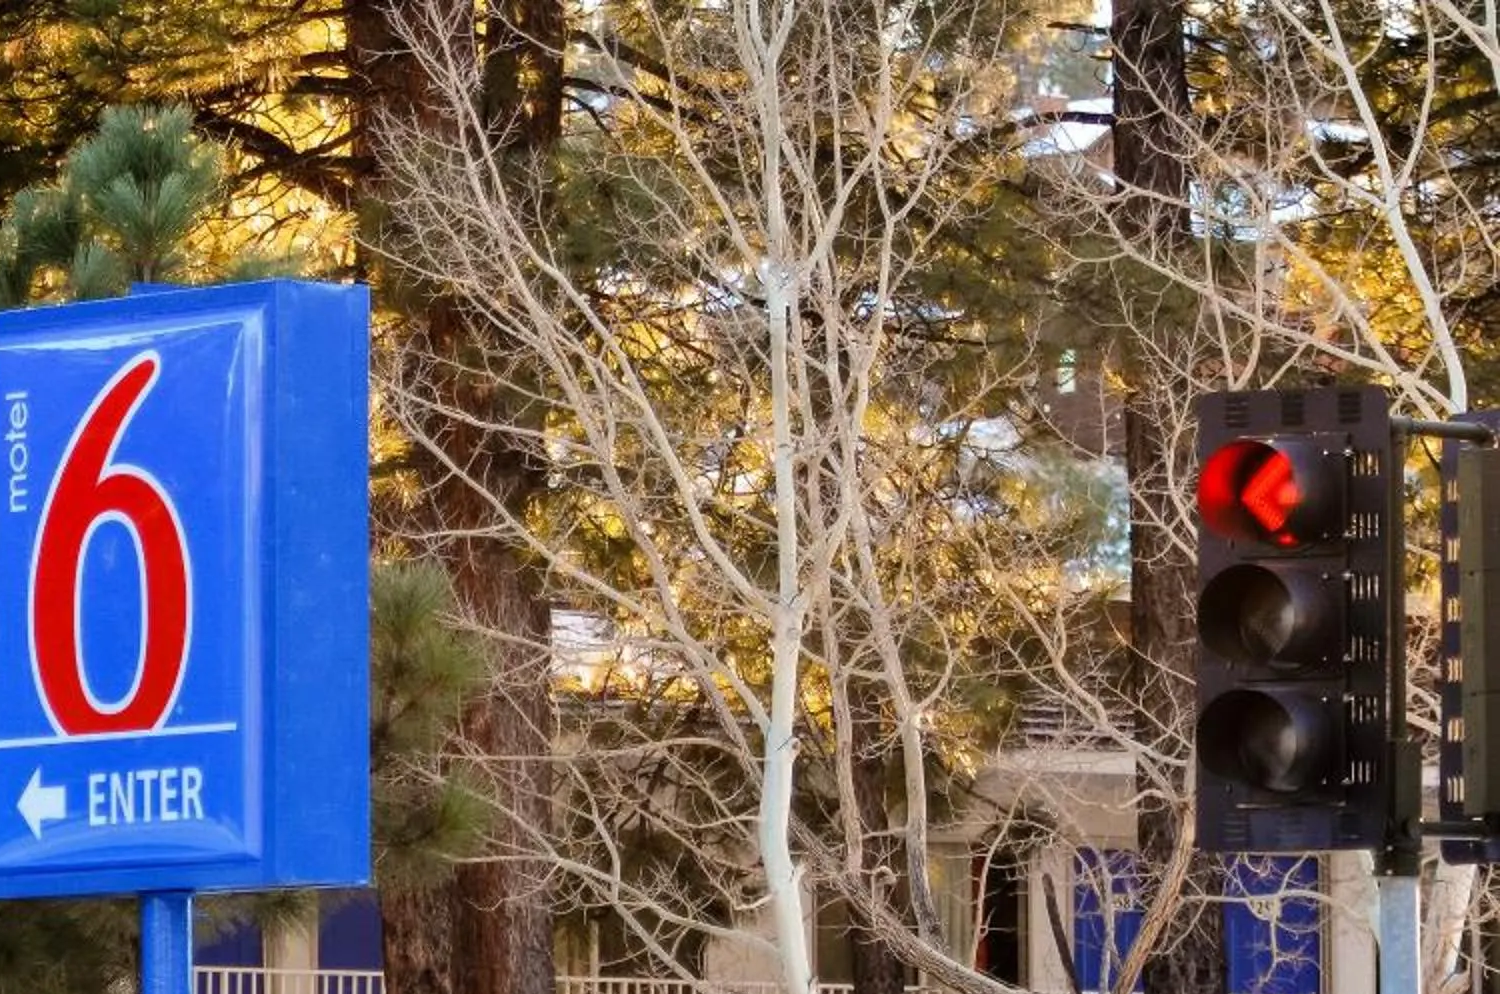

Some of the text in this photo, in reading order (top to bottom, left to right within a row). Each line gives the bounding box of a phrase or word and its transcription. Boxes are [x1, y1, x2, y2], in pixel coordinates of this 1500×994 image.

[5, 391, 28, 512] motel
[28, 350, 192, 736] 6
[89, 766, 204, 827] ENTER
